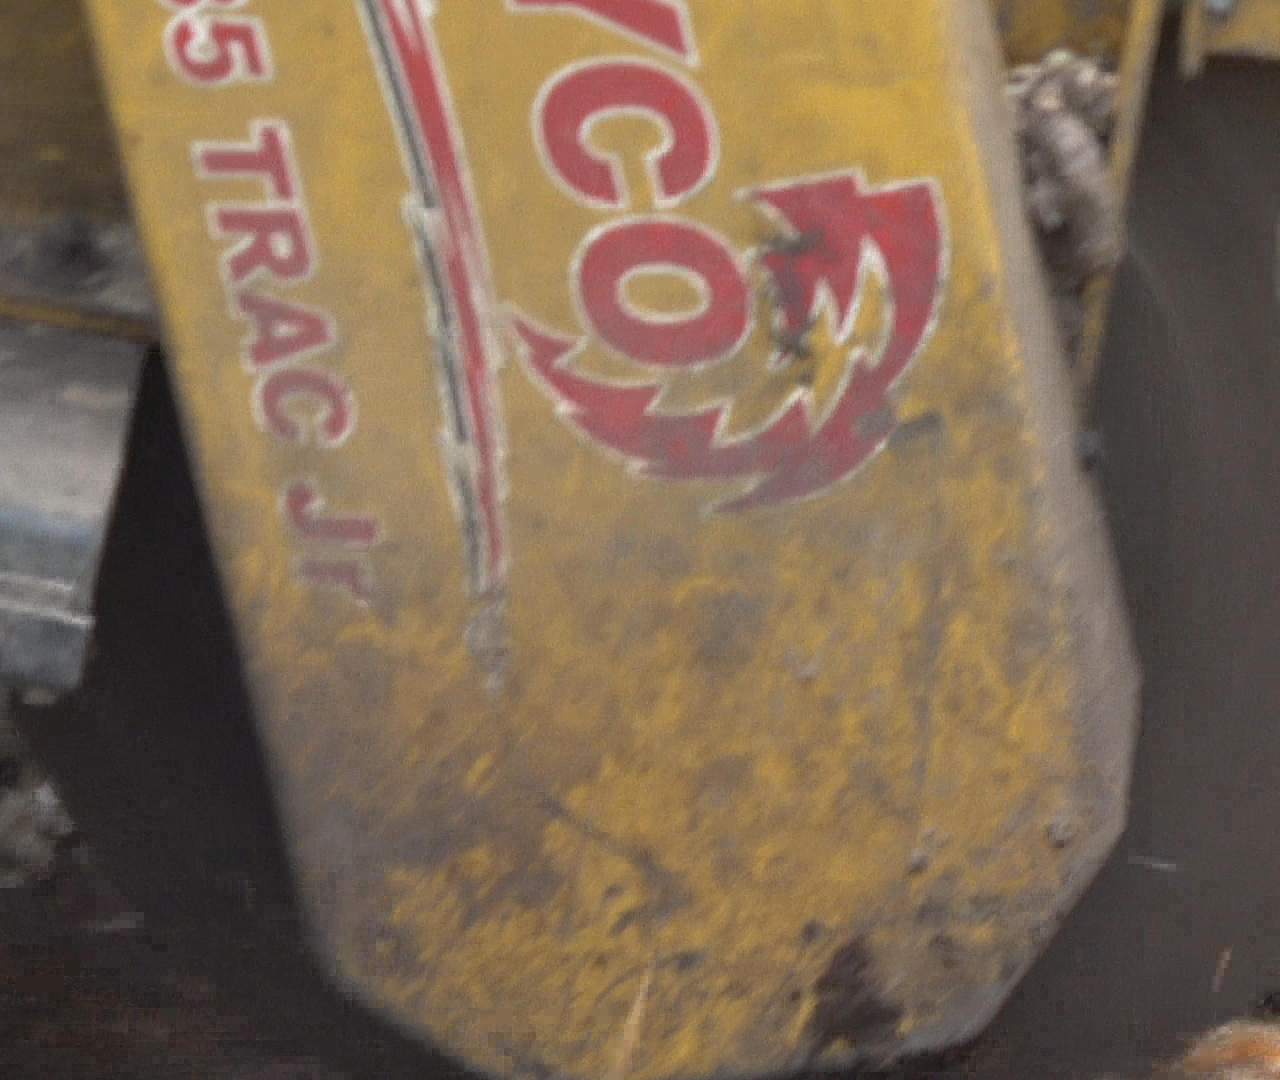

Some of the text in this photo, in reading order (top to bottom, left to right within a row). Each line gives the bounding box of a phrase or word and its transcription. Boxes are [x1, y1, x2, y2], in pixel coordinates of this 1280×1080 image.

[161, 0, 383, 606] 5 TRAC Jr
